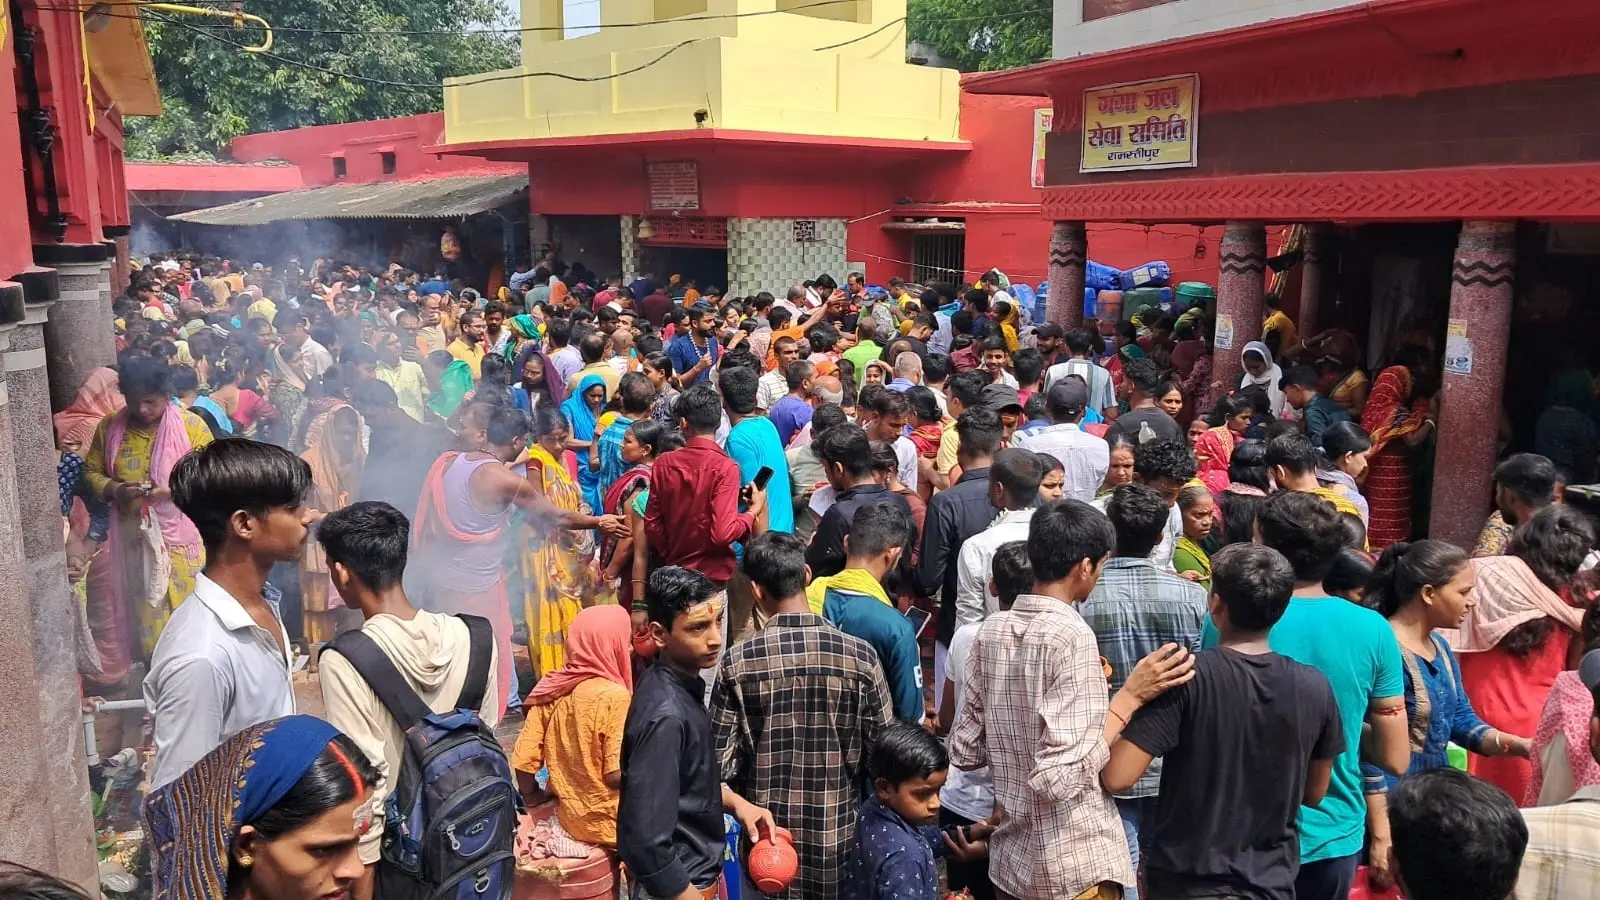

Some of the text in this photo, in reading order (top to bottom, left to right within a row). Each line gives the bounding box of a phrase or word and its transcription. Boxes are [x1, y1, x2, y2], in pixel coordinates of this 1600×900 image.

[1144, 87, 1179, 109] जल
[1088, 114, 1187, 148] सेवा समिति
